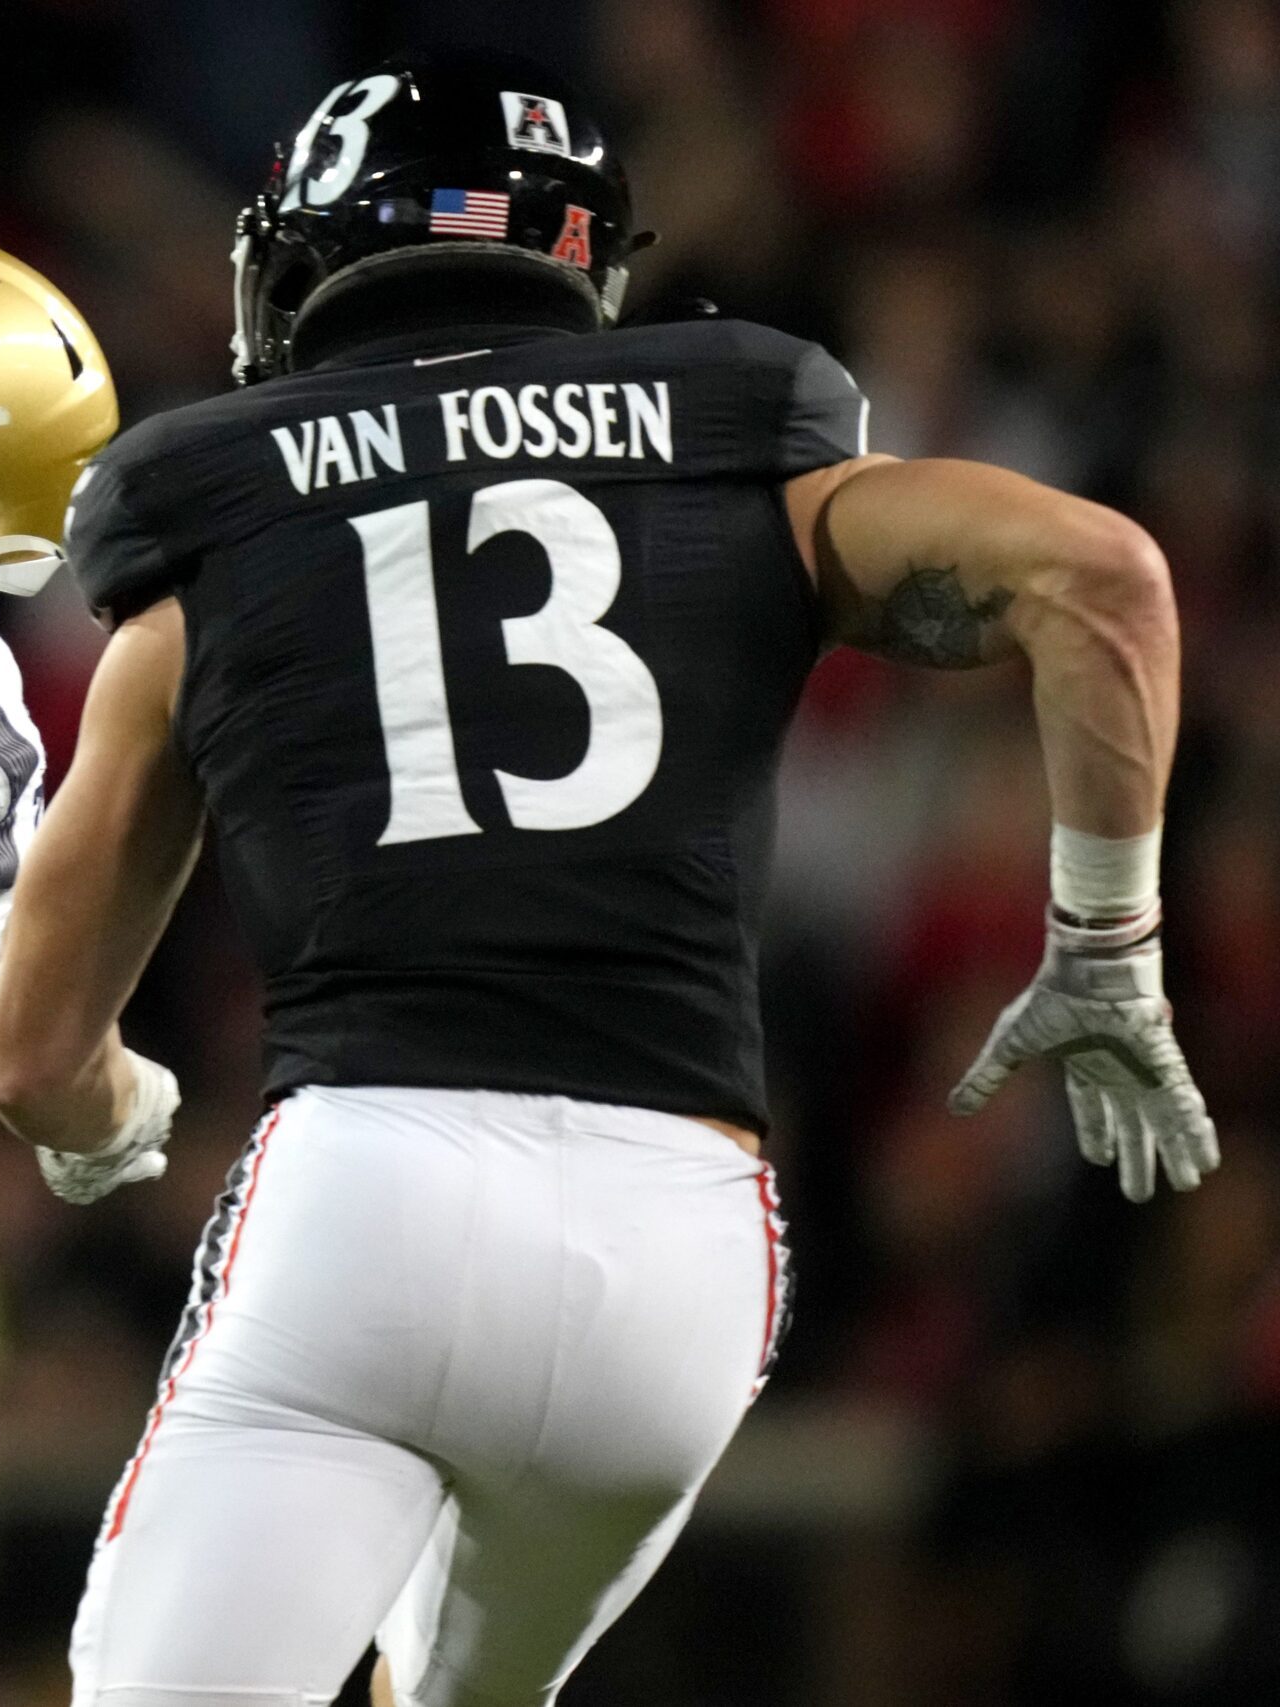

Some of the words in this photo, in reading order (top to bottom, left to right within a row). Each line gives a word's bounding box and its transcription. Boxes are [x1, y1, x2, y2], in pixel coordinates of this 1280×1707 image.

[278, 74, 401, 214] 13
[514, 95, 564, 144] A
[270, 404, 406, 495] VAN
[438, 381, 673, 463] FOSSEN
[347, 478, 663, 846] 13
